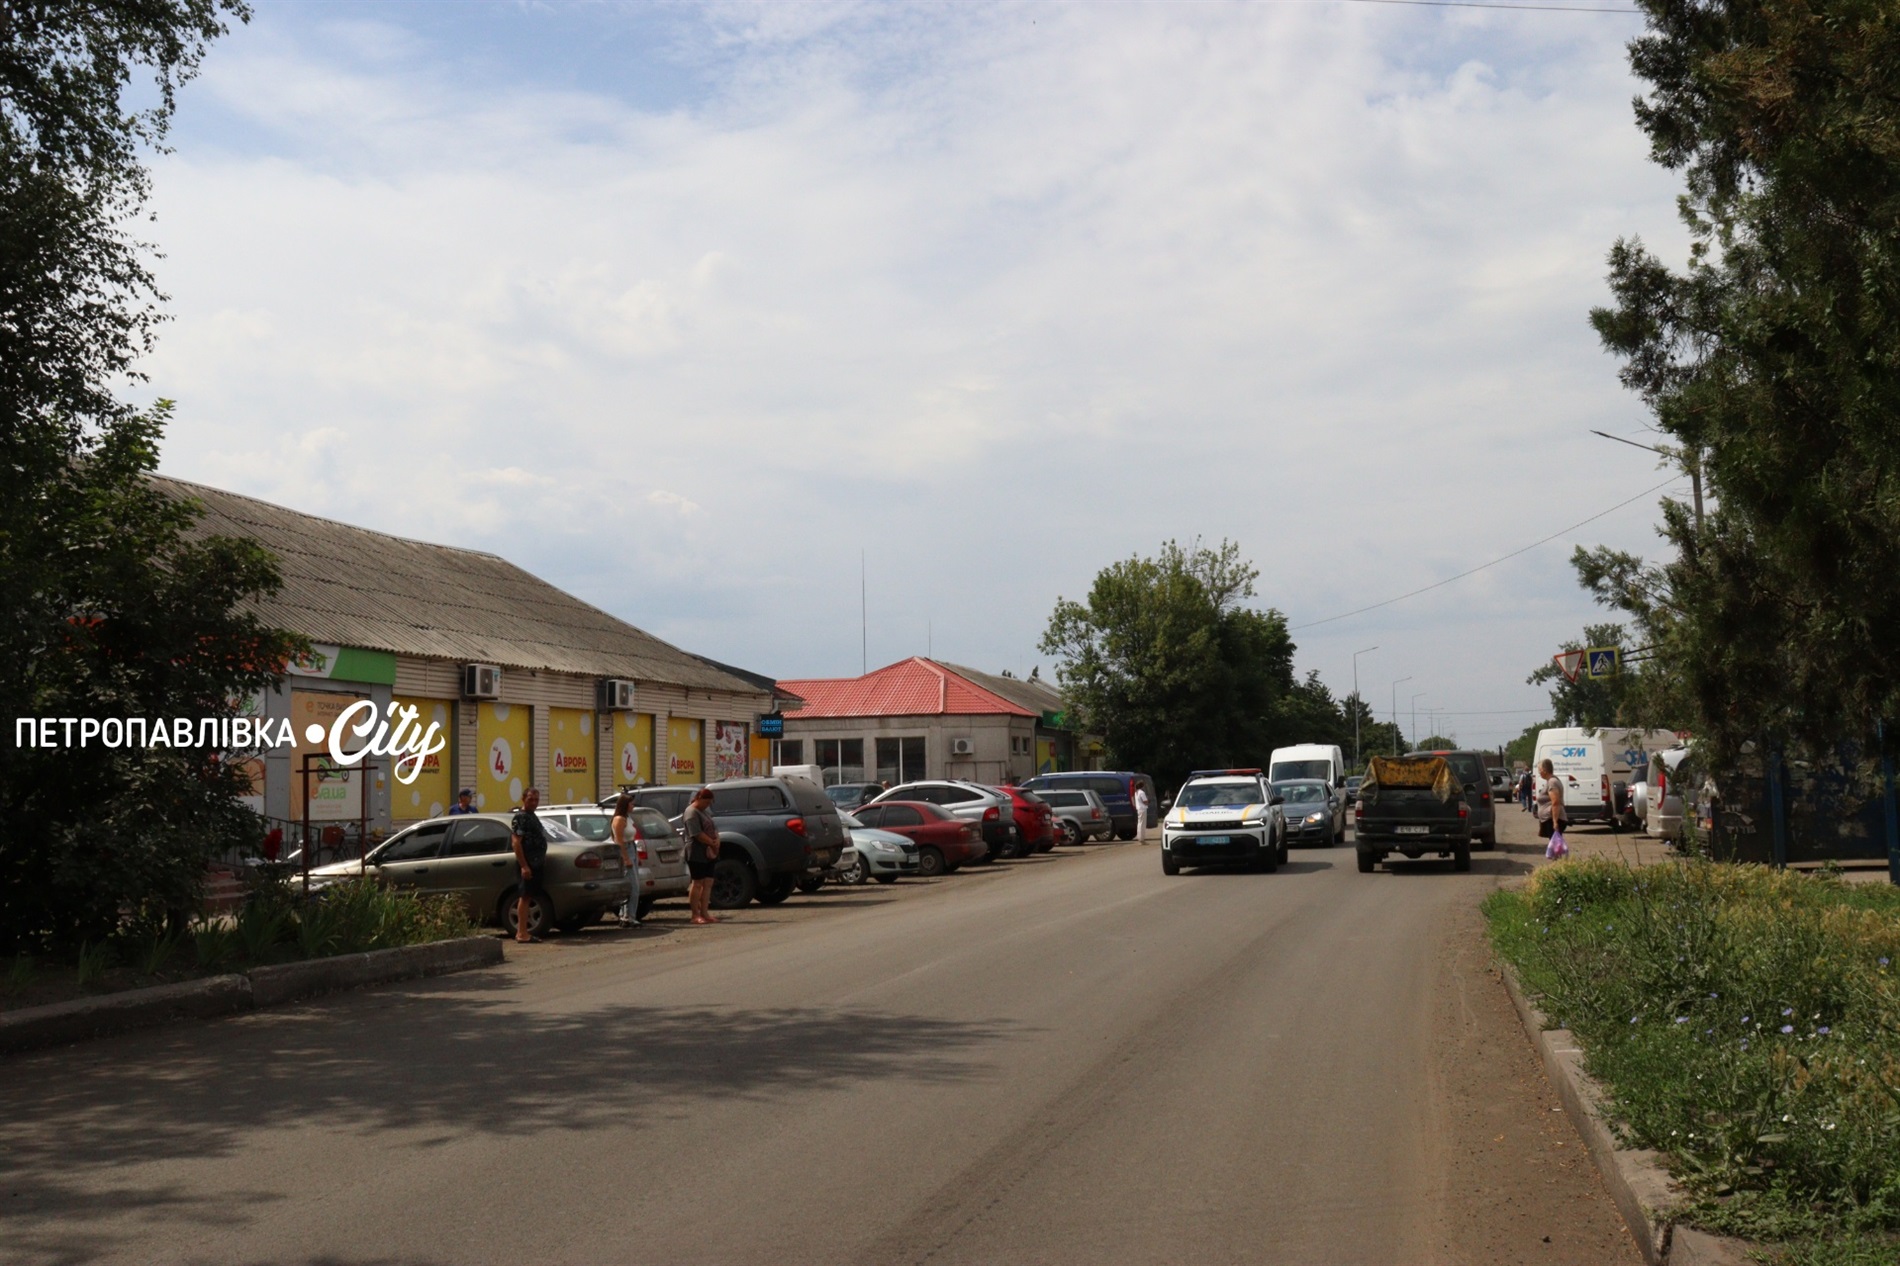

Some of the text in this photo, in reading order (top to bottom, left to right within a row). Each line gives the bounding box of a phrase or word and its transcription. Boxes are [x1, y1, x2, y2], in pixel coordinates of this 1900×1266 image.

[495, 752, 504, 774] 4
[555, 752, 587, 768] АВРОРА
[626, 754, 633, 774] 4
